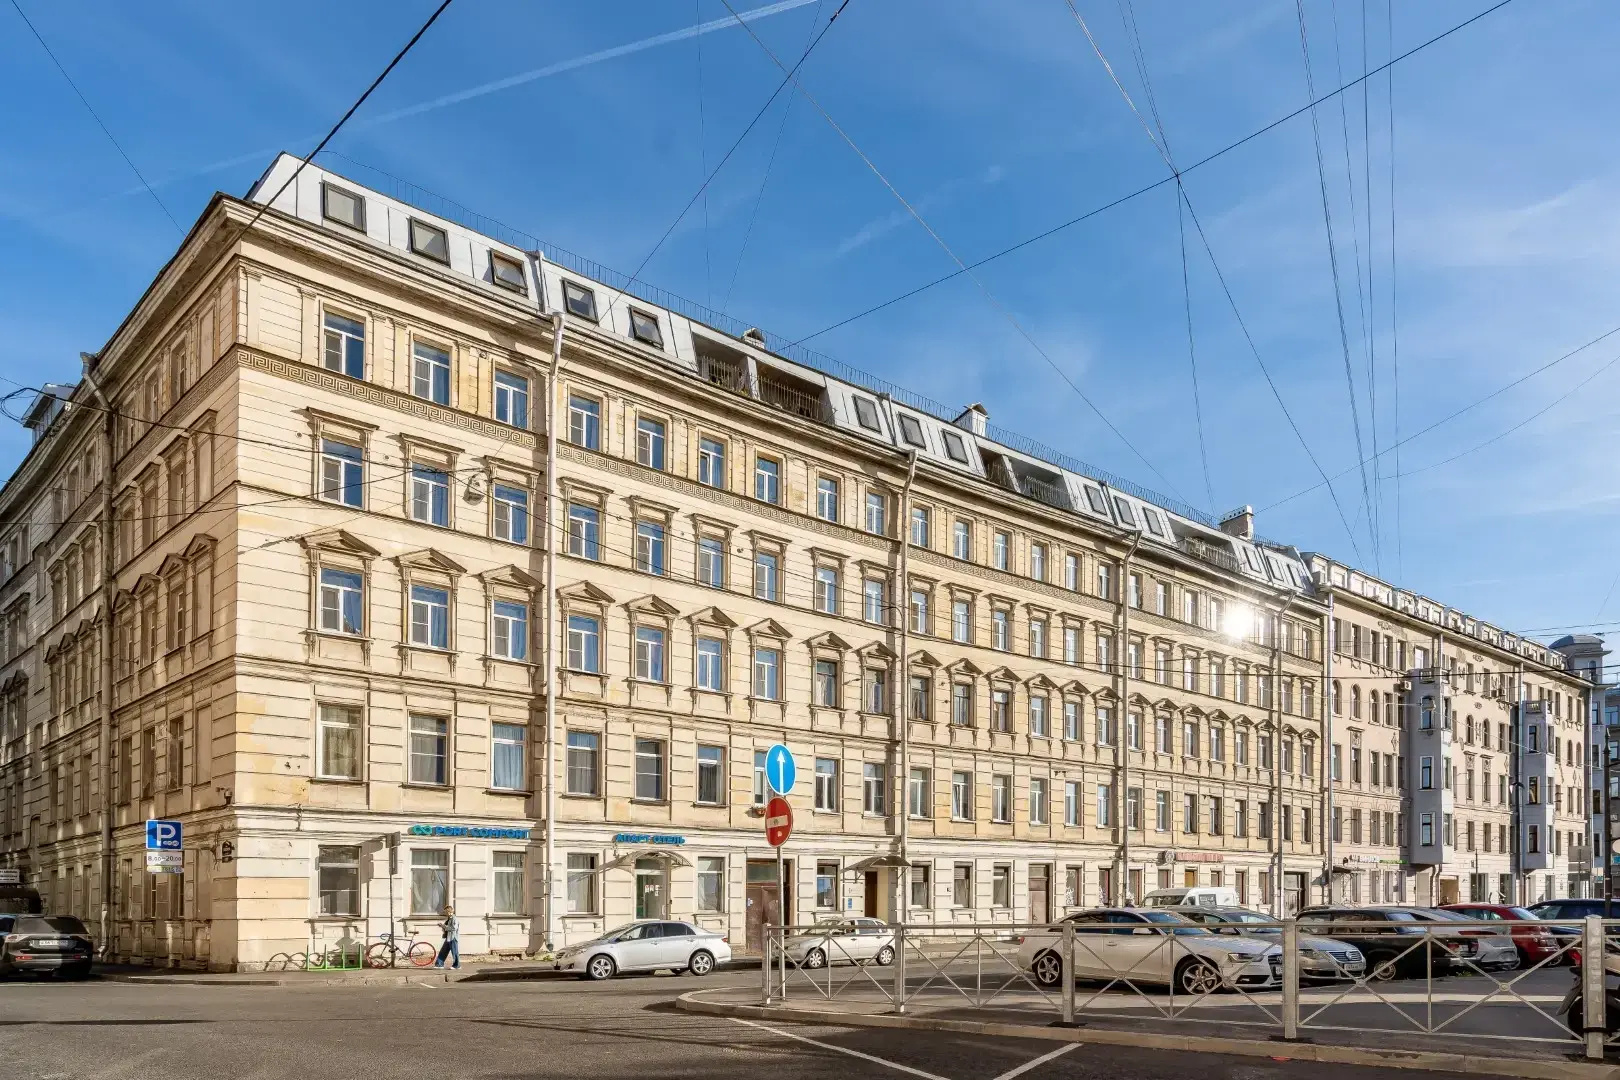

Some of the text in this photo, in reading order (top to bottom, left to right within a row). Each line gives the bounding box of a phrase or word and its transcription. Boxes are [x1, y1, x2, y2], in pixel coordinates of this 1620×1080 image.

[156, 823, 176, 847] P
[434, 826, 530, 839] PORT COMFORT
